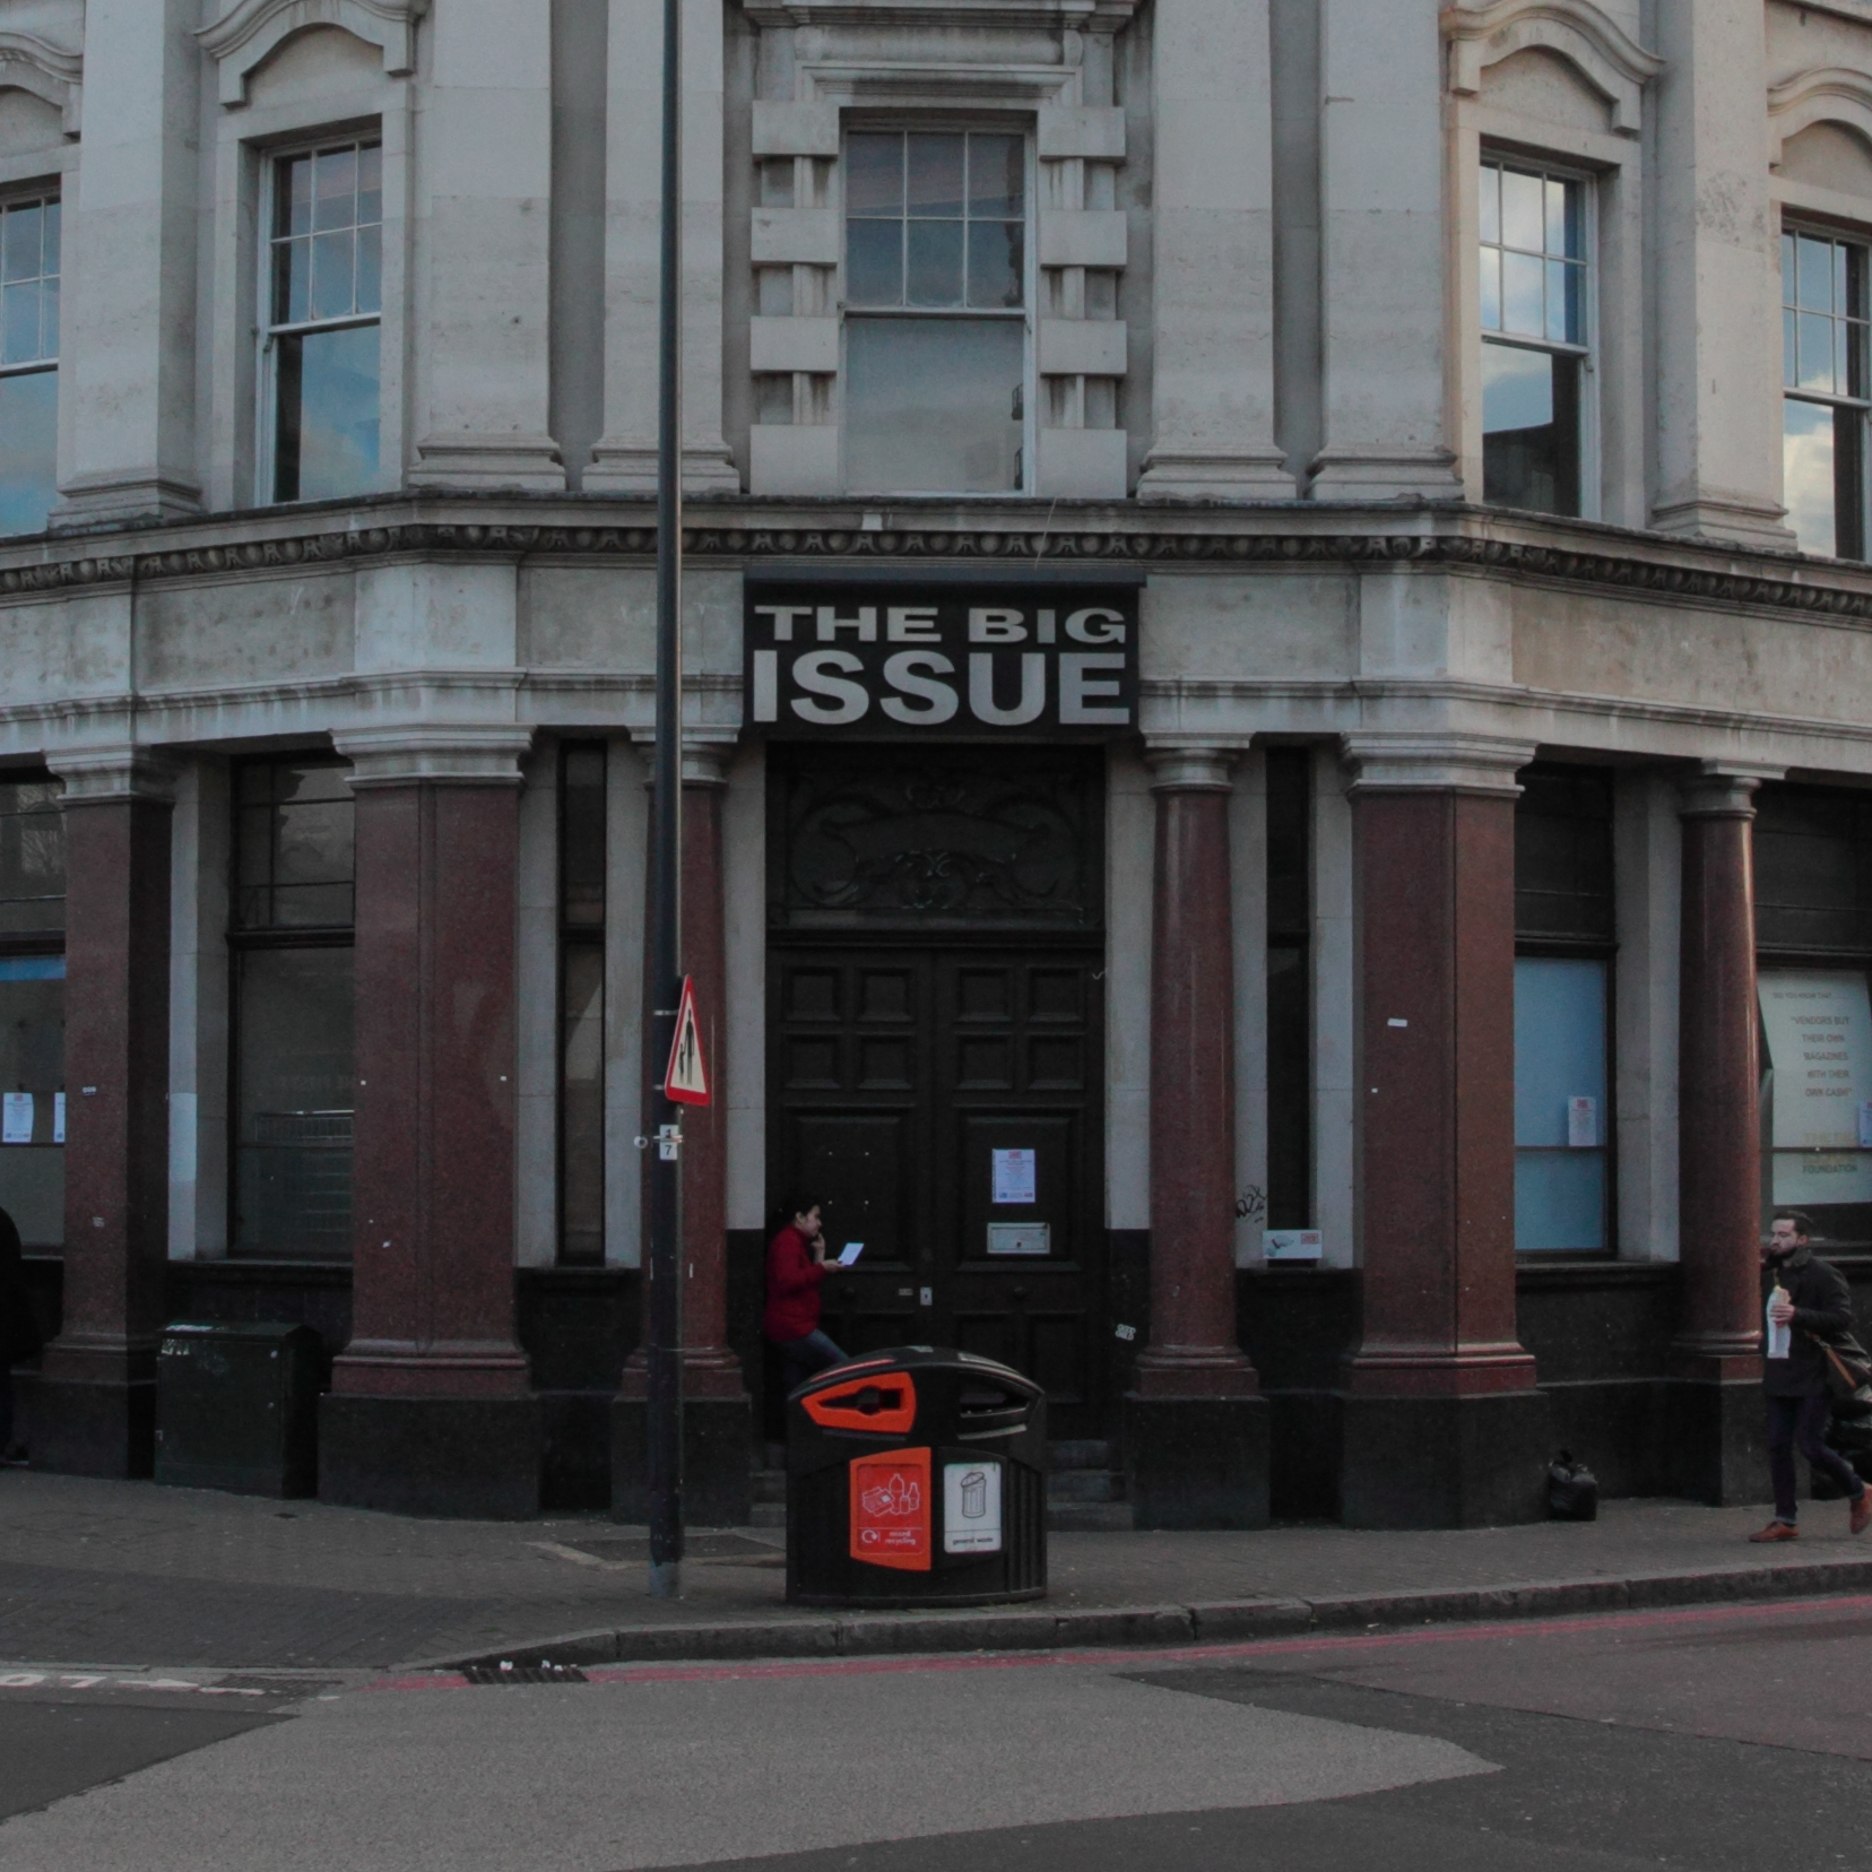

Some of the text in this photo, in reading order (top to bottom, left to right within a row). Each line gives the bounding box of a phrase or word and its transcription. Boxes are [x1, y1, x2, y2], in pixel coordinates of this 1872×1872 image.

[754, 605, 1127, 644] THE BIG
[753, 649, 1130, 726] ISSUE
[665, 1144, 673, 1156] 7
